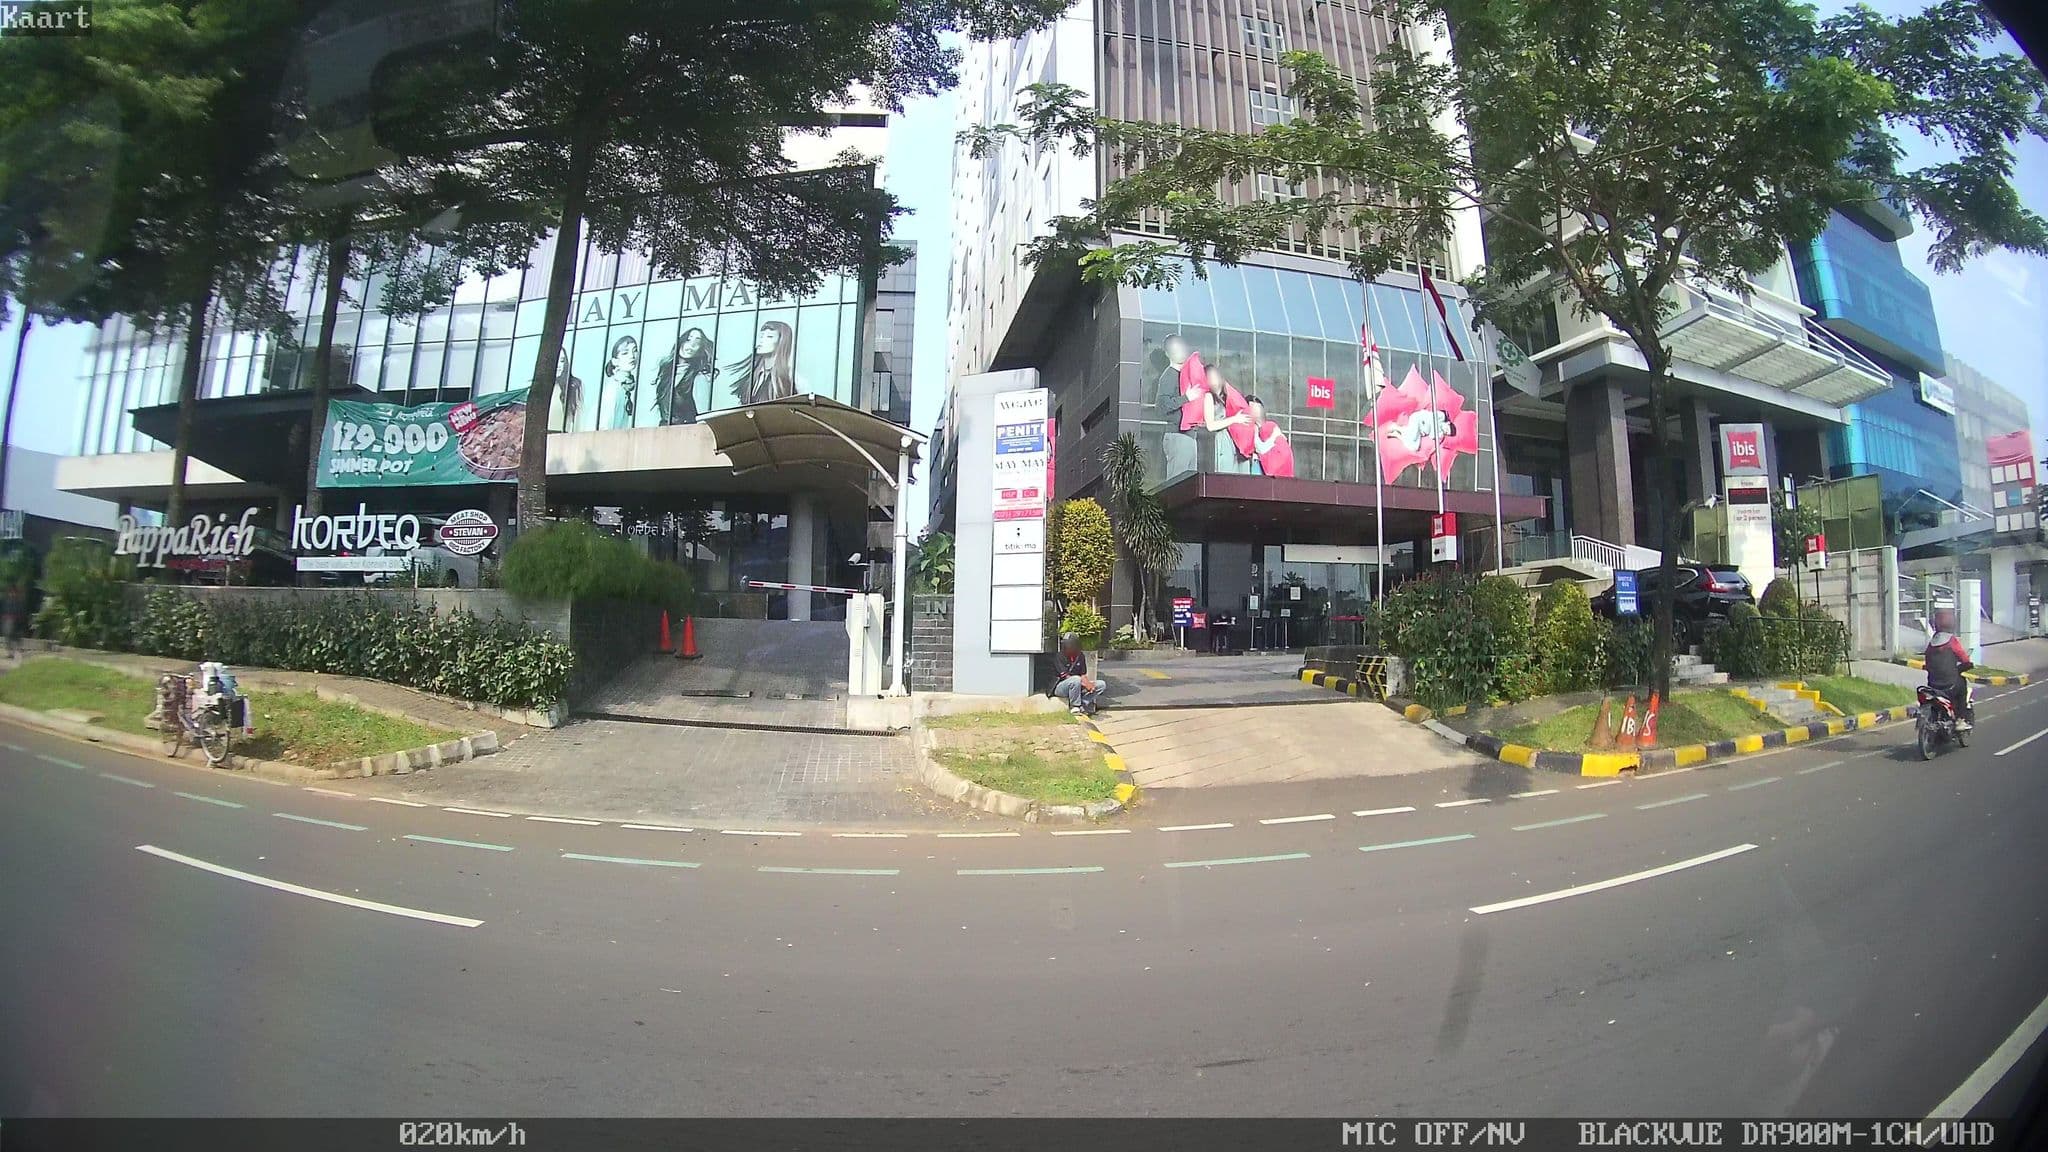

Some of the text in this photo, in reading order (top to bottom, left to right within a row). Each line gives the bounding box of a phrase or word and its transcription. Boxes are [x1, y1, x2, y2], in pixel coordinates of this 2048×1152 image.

[1310, 384, 1331, 399] ibis
[332, 420, 449, 455] 129.000
[1733, 440, 1755, 456] ibis
[378, 459, 414, 476] POT
[450, 511, 488, 523] MEAT SHOP
[115, 506, 258, 569] PappaRich
[453, 527, 484, 537] STEVAN
[925, 599, 947, 617] IN
